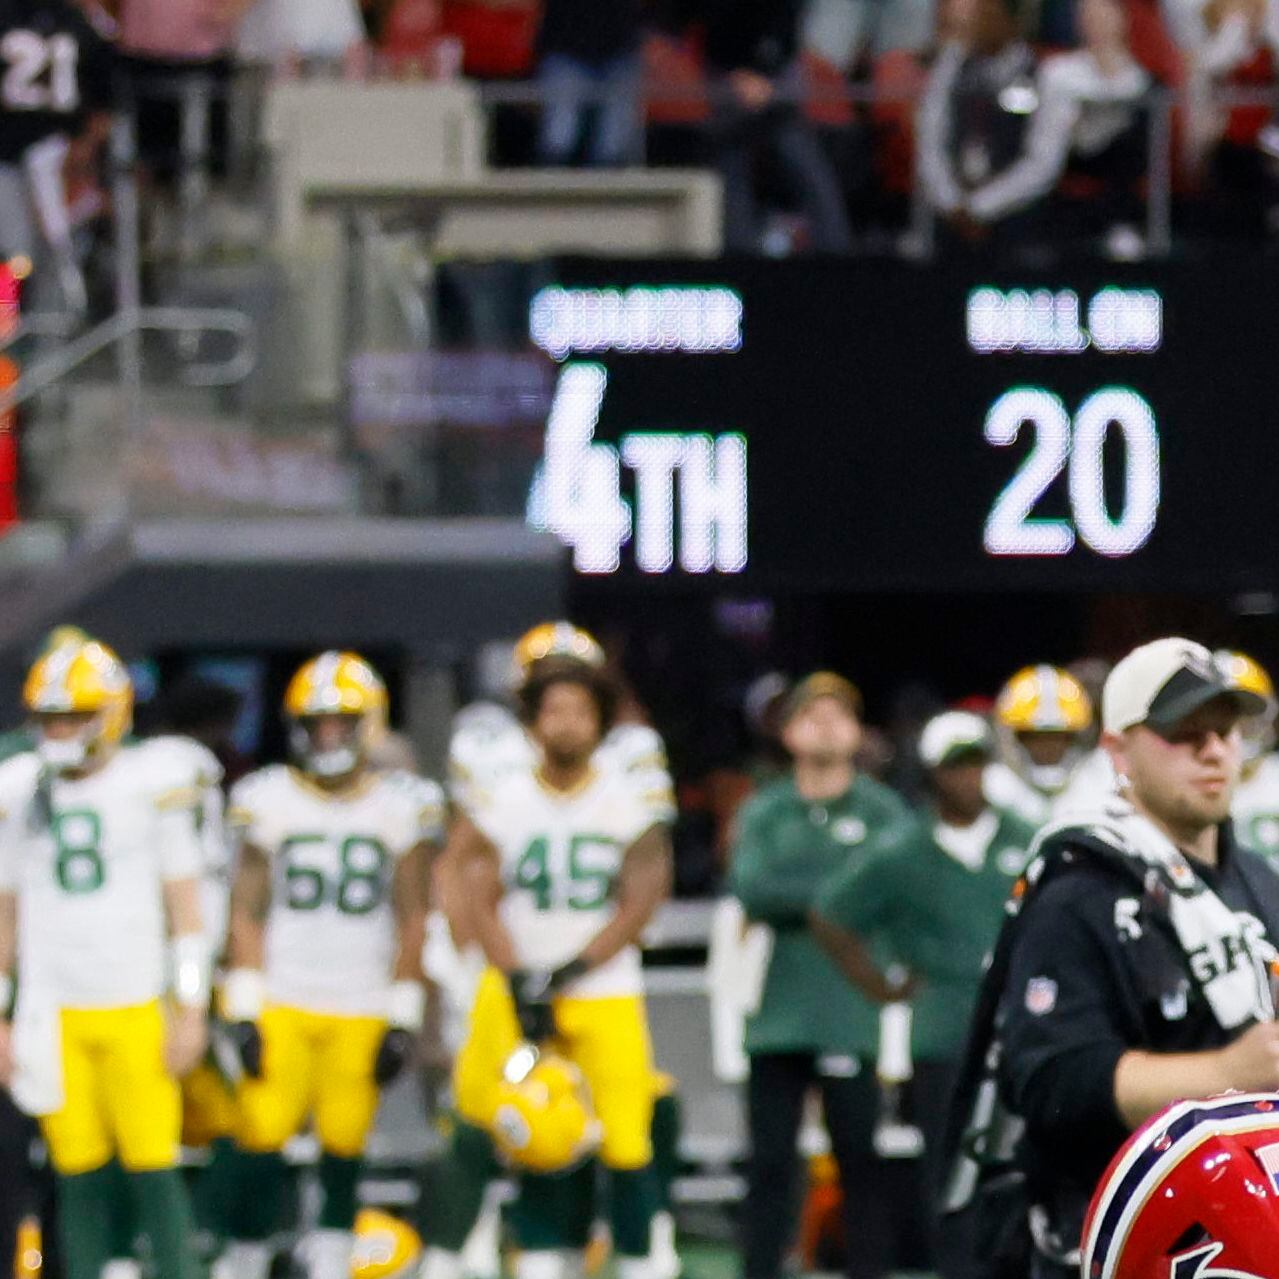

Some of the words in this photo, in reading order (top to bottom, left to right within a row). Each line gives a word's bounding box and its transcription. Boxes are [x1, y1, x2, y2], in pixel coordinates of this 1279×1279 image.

[0, 29, 80, 112] 21
[527, 362, 748, 573] 4TH
[982, 386, 1161, 556] 20
[52, 810, 105, 893] 8
[514, 834, 622, 911] 45
